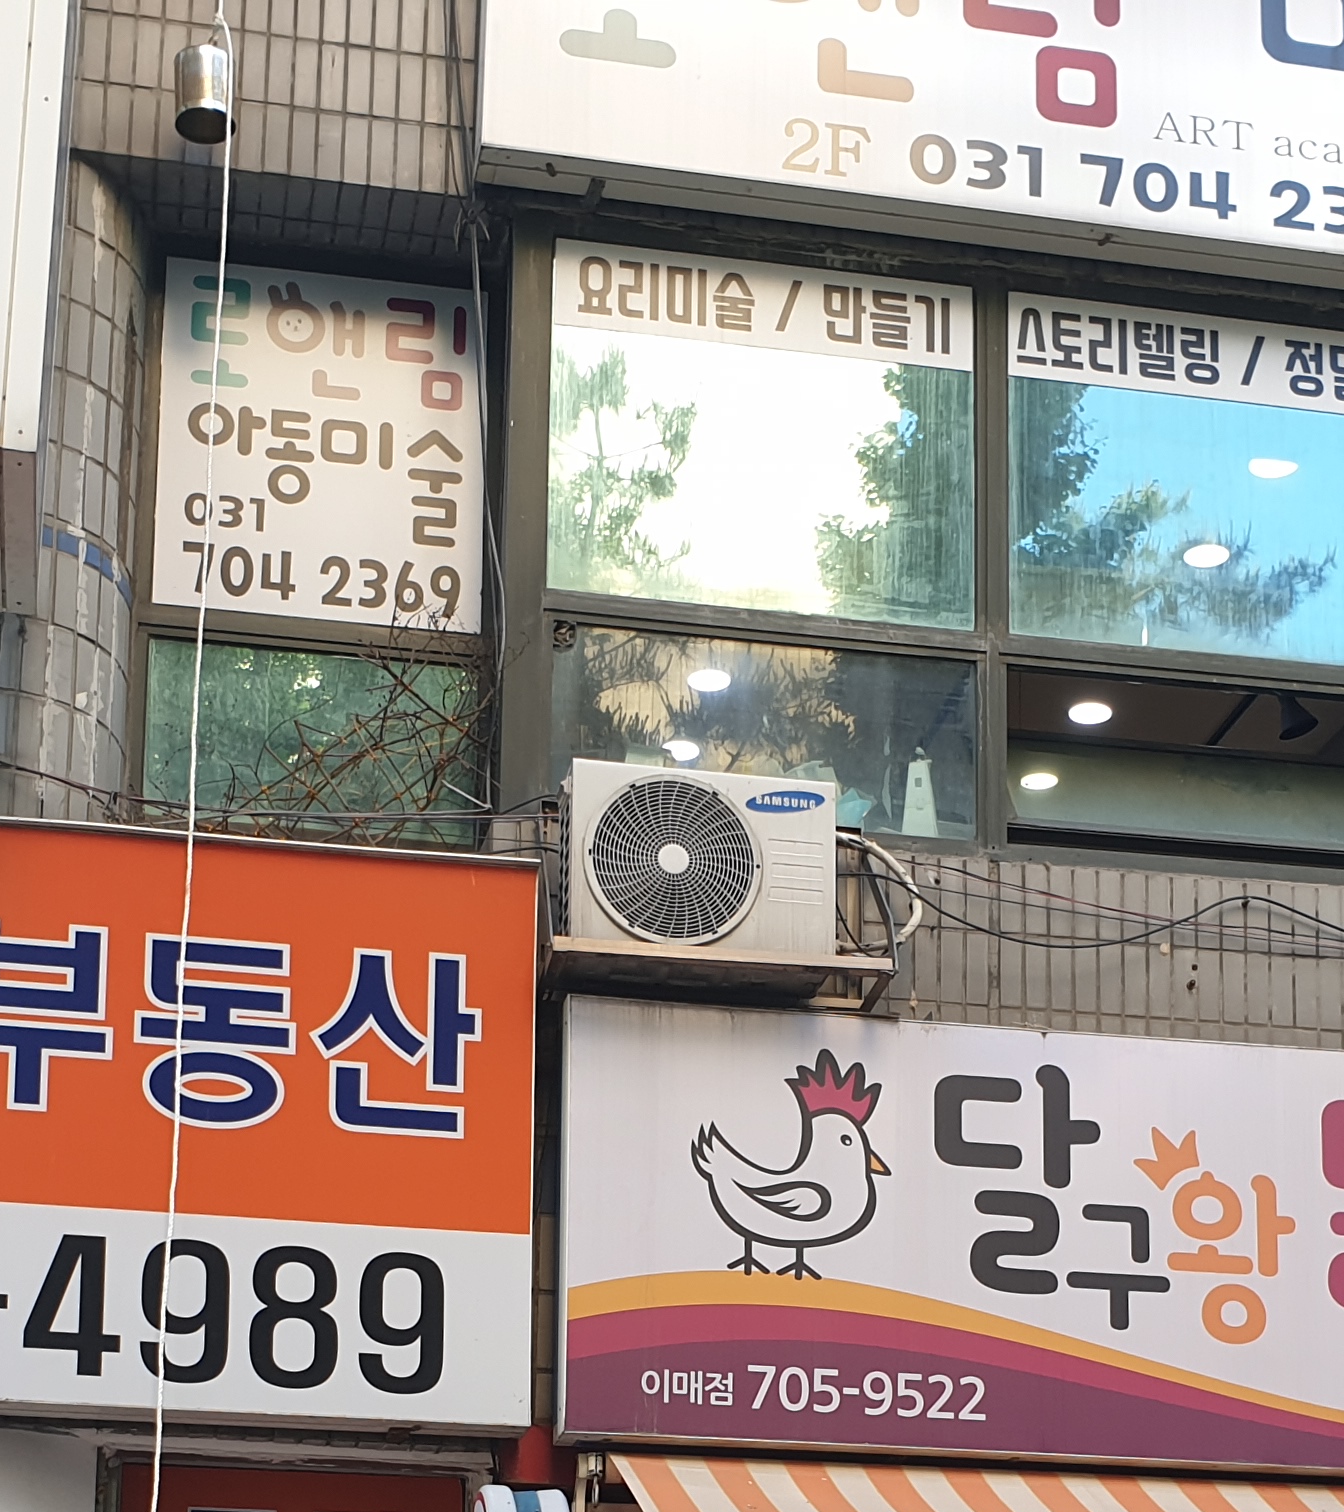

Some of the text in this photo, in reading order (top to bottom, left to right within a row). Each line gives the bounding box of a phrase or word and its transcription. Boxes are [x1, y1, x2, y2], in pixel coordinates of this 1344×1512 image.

[782, 117, 873, 179] 2F
[909, 132, 1044, 200] 031
[1077, 153, 1240, 219] 704
[1154, 110, 1256, 154] ART
[577, 255, 755, 332] 요리미술
[822, 285, 950, 356] 만들기
[1015, 303, 1222, 389] 스토리텔링
[182, 492, 266, 532] 031
[186, 400, 465, 547] 아동미술
[181, 541, 463, 621] 704 2369
[754, 794, 817, 809] SAMSUNG
[932, 1062, 1297, 1347] 달구왕
[638, 1361, 988, 1423] 이매점 705-9522
